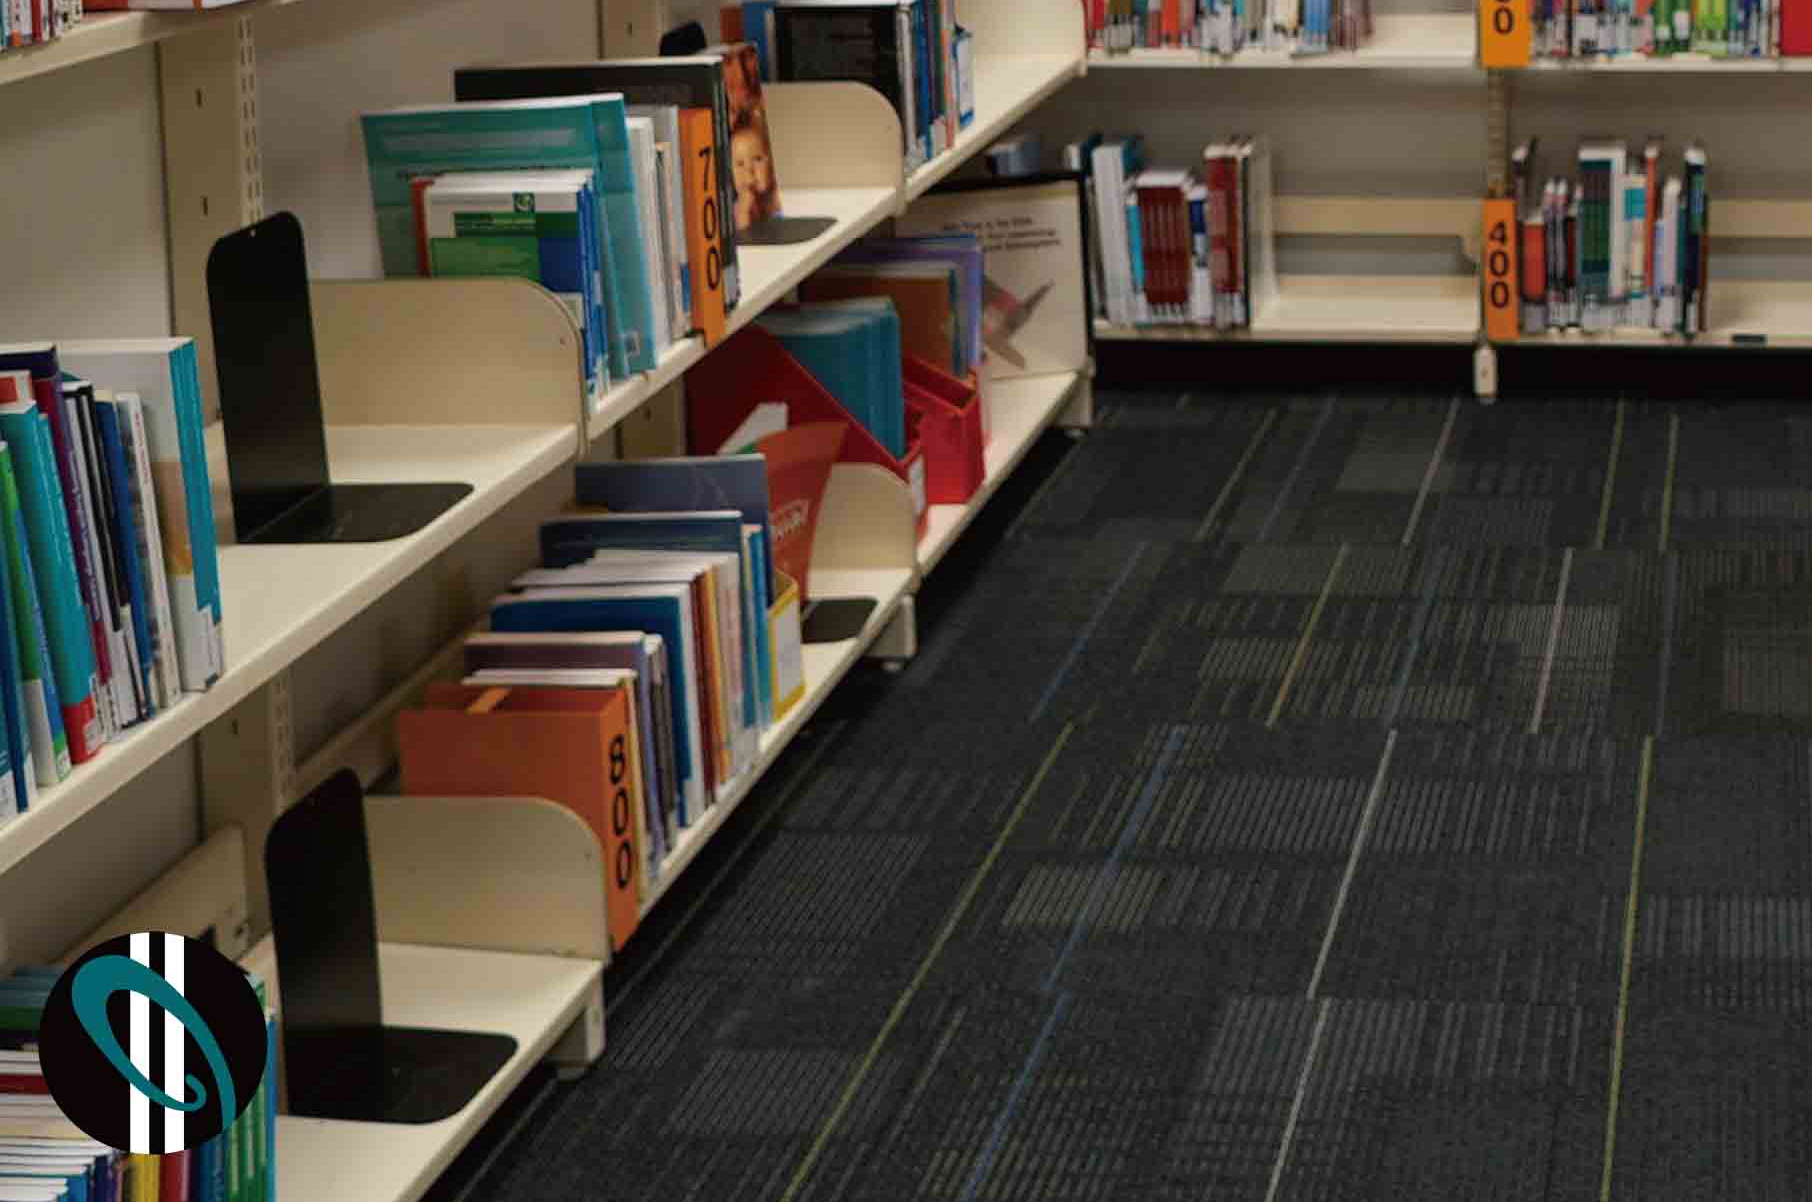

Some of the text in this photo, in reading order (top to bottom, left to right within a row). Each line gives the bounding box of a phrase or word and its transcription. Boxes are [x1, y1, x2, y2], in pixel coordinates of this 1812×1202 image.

[699, 146, 722, 290] 700
[1490, 220, 1510, 308] 400
[608, 734, 633, 891] 800
